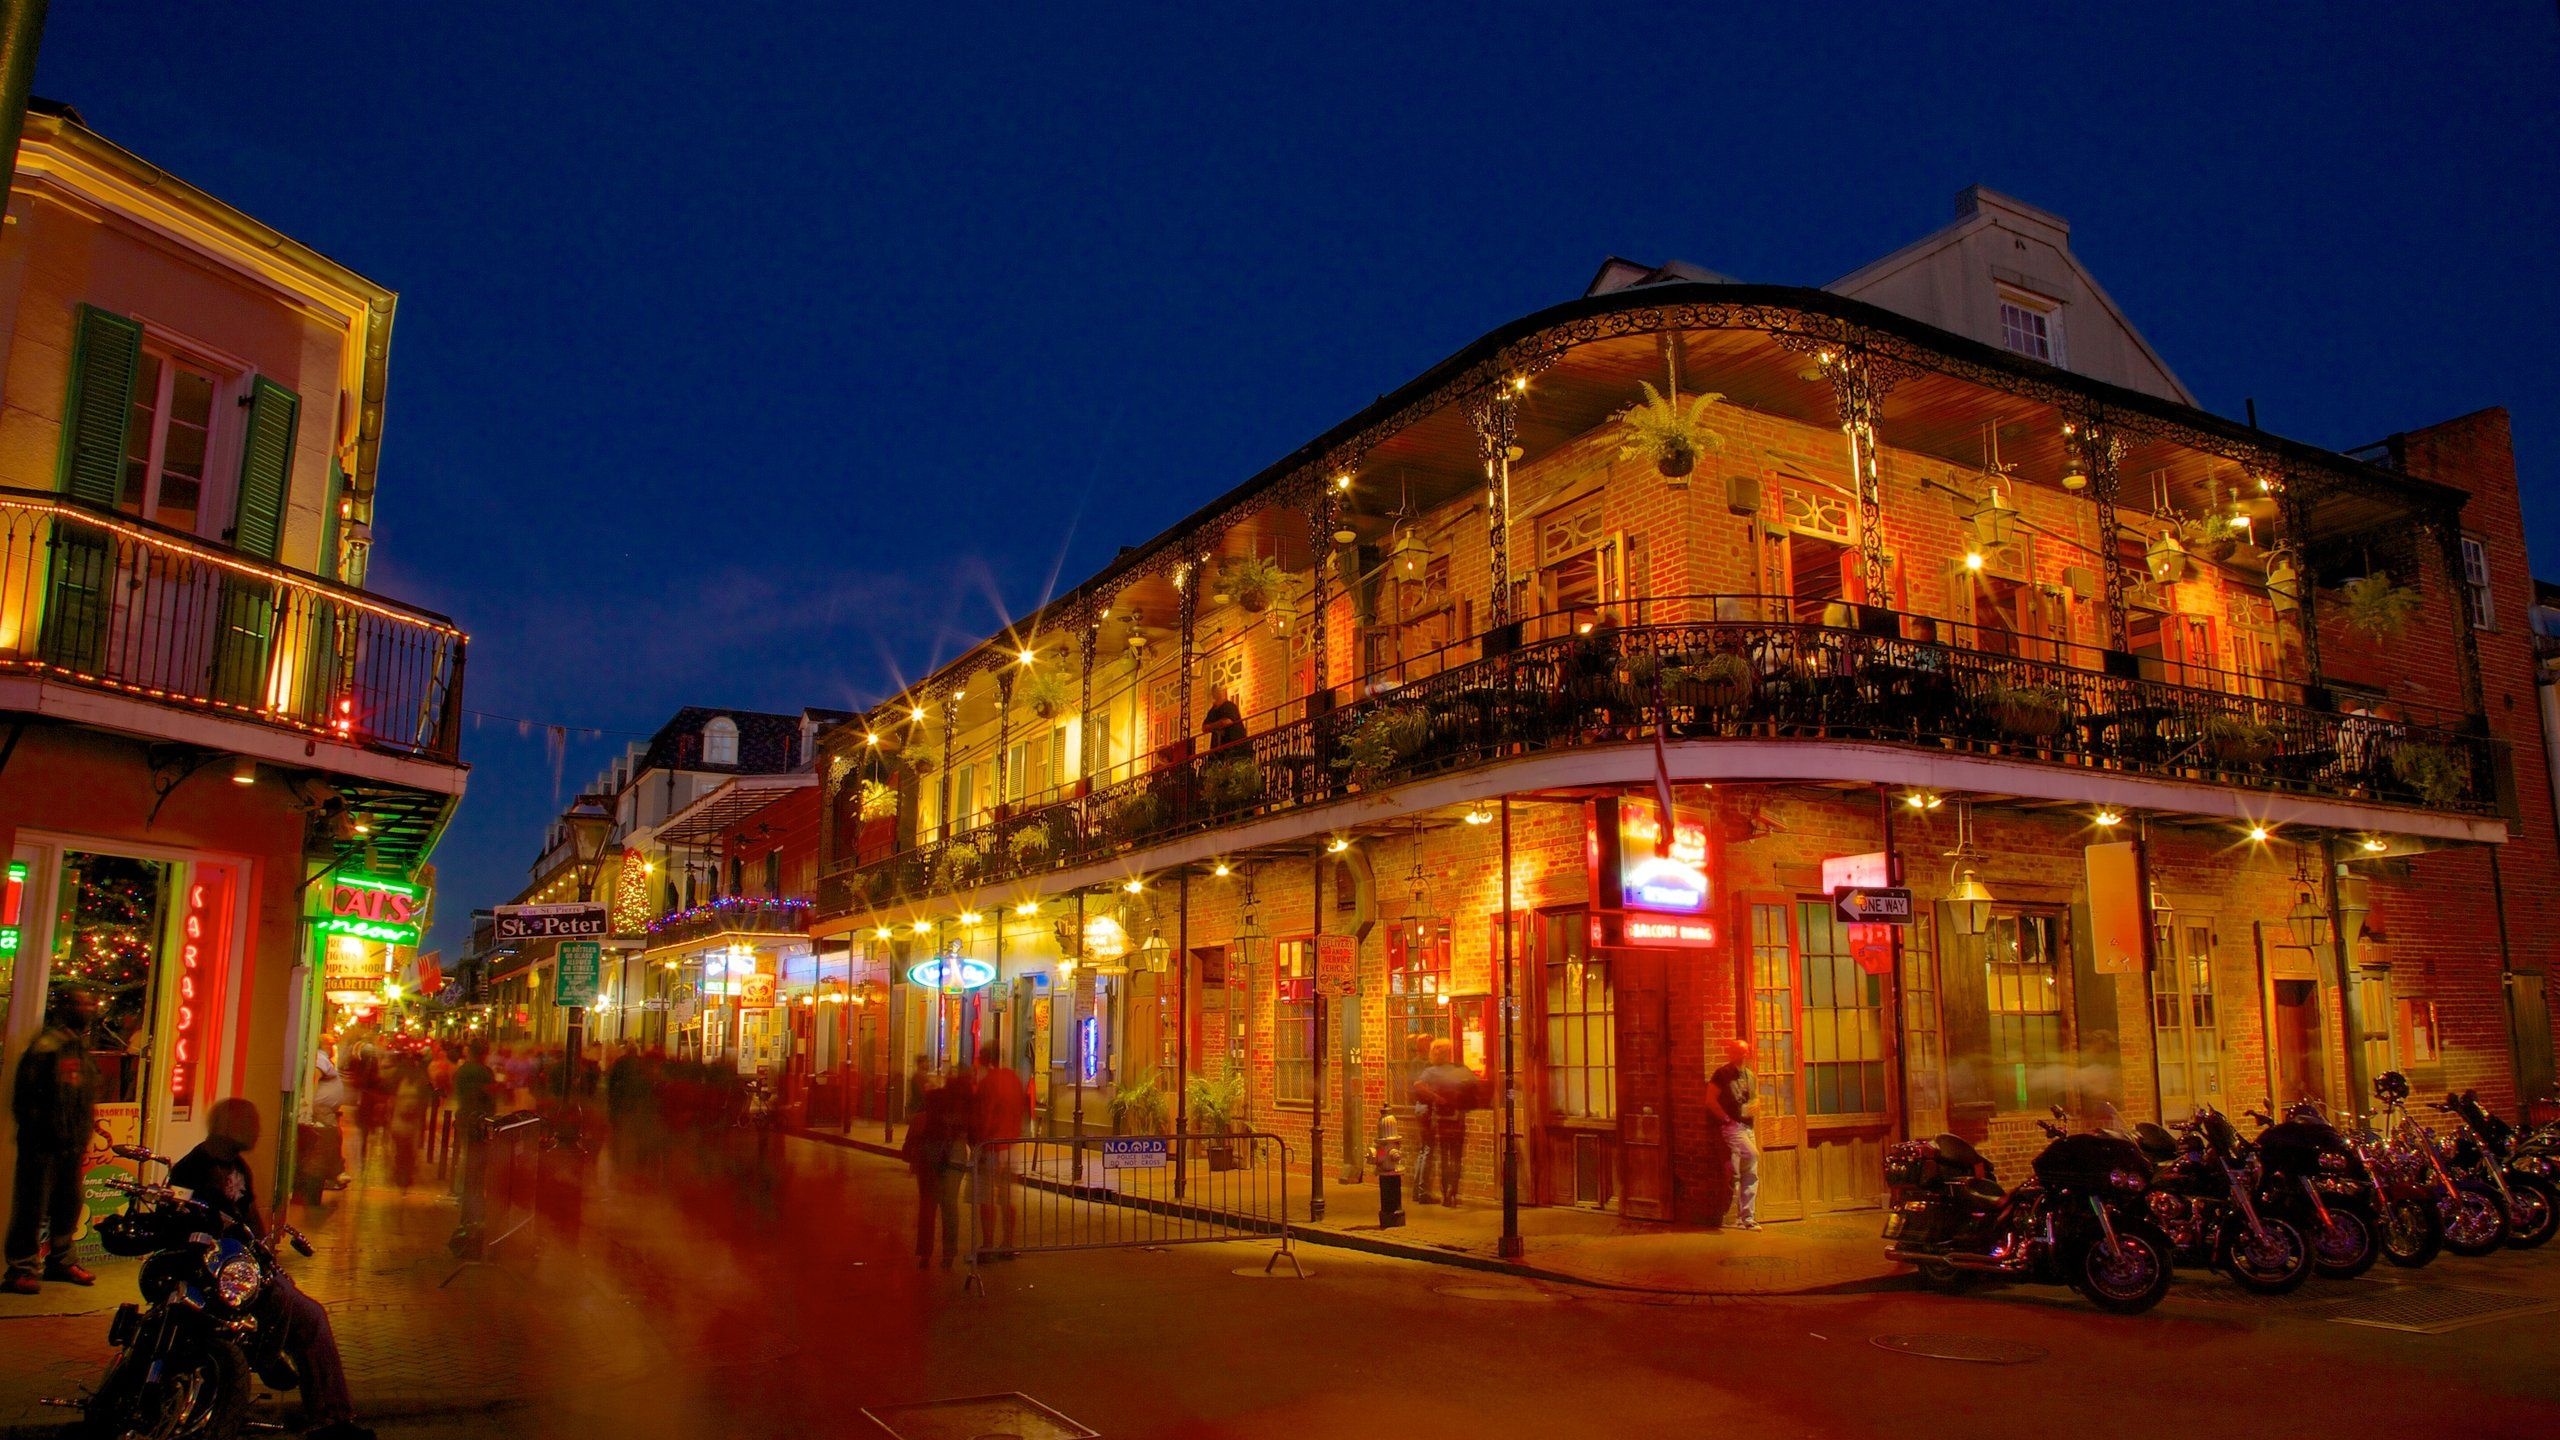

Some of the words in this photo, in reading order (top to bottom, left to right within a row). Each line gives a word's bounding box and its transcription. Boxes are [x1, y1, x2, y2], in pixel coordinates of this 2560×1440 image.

[1860, 899, 1883, 912] ONE
[1885, 899, 1905, 912] WAY
[501, 919, 532, 936] St.
[544, 917, 601, 935] Peter
[94, 1108, 124, 1117] ARAOKE
